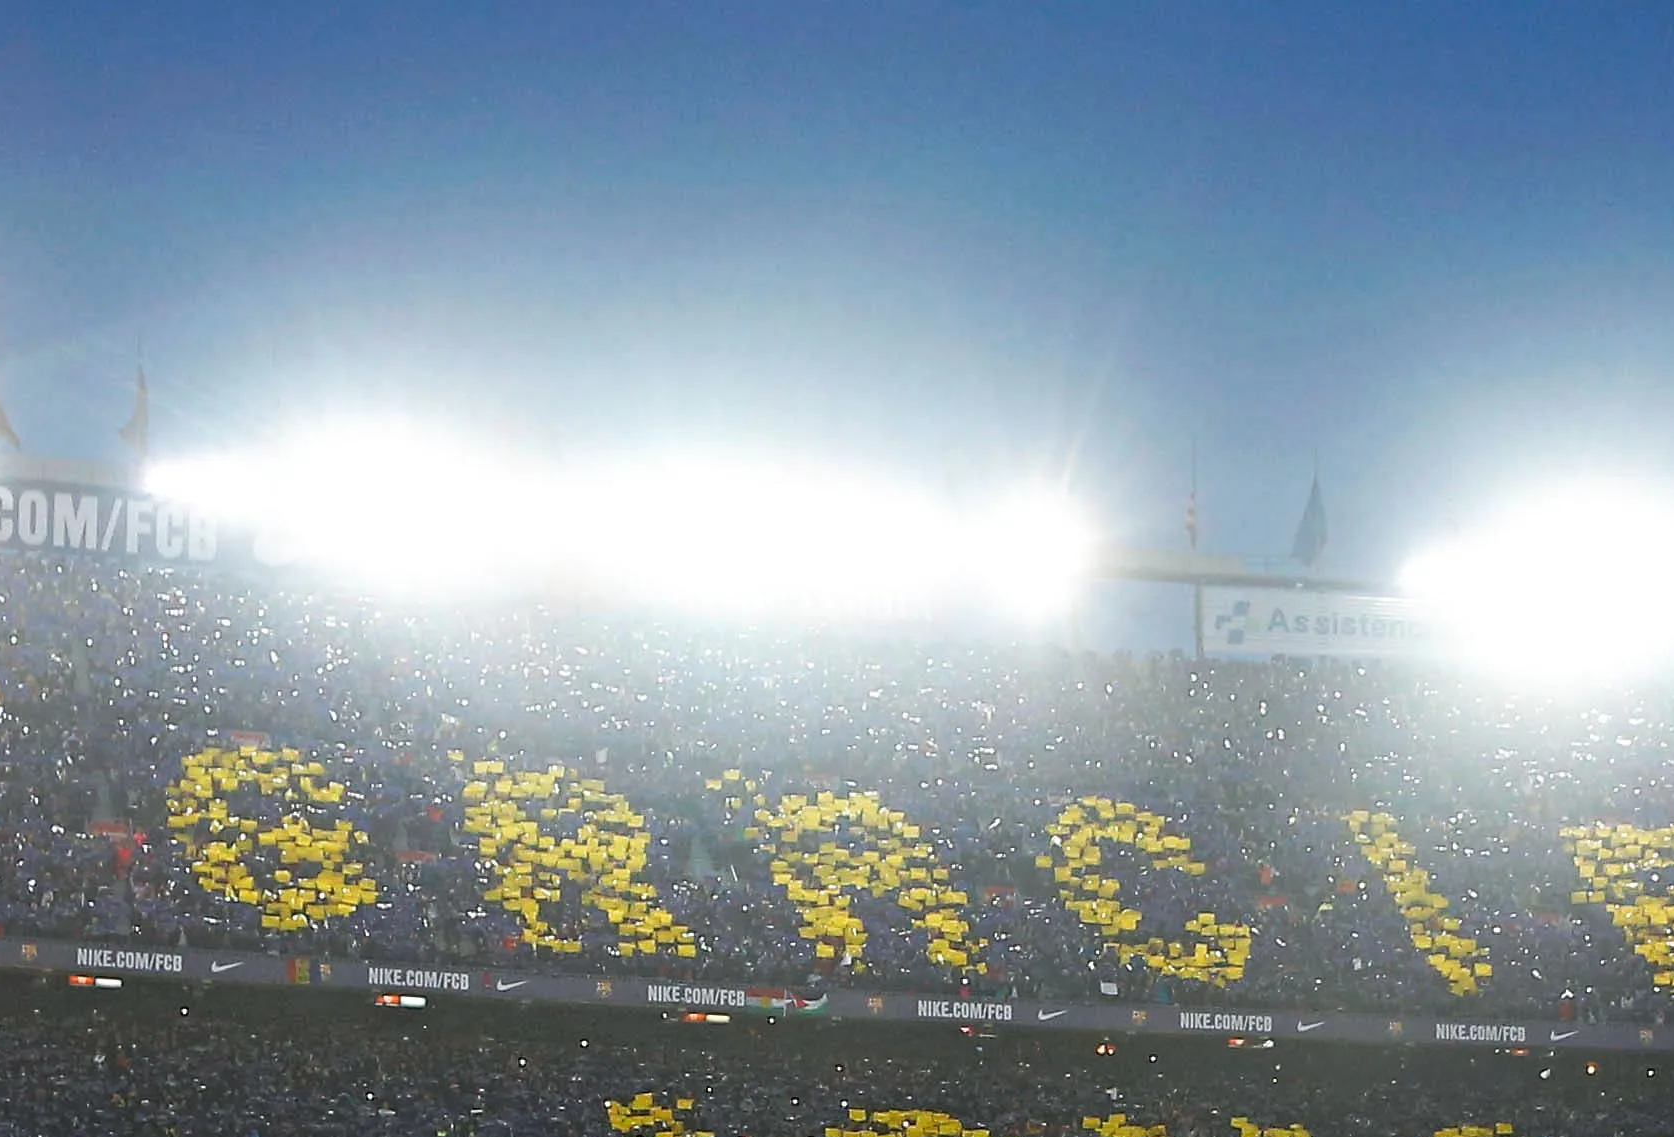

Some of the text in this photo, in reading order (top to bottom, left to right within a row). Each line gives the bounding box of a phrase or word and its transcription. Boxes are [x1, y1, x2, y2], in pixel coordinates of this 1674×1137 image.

[78, 947, 183, 972] NIKE.COM/FCB
[369, 966, 470, 991] NIKE.COM/FCB
[647, 983, 745, 1008] NIKE.COM/FCB
[918, 999, 1013, 1022] NIKE.COM/FCB
[1179, 1011, 1272, 1033] NIKE.COM/FCB
[1435, 1024, 1527, 1044] NIKE.COM/FCB
